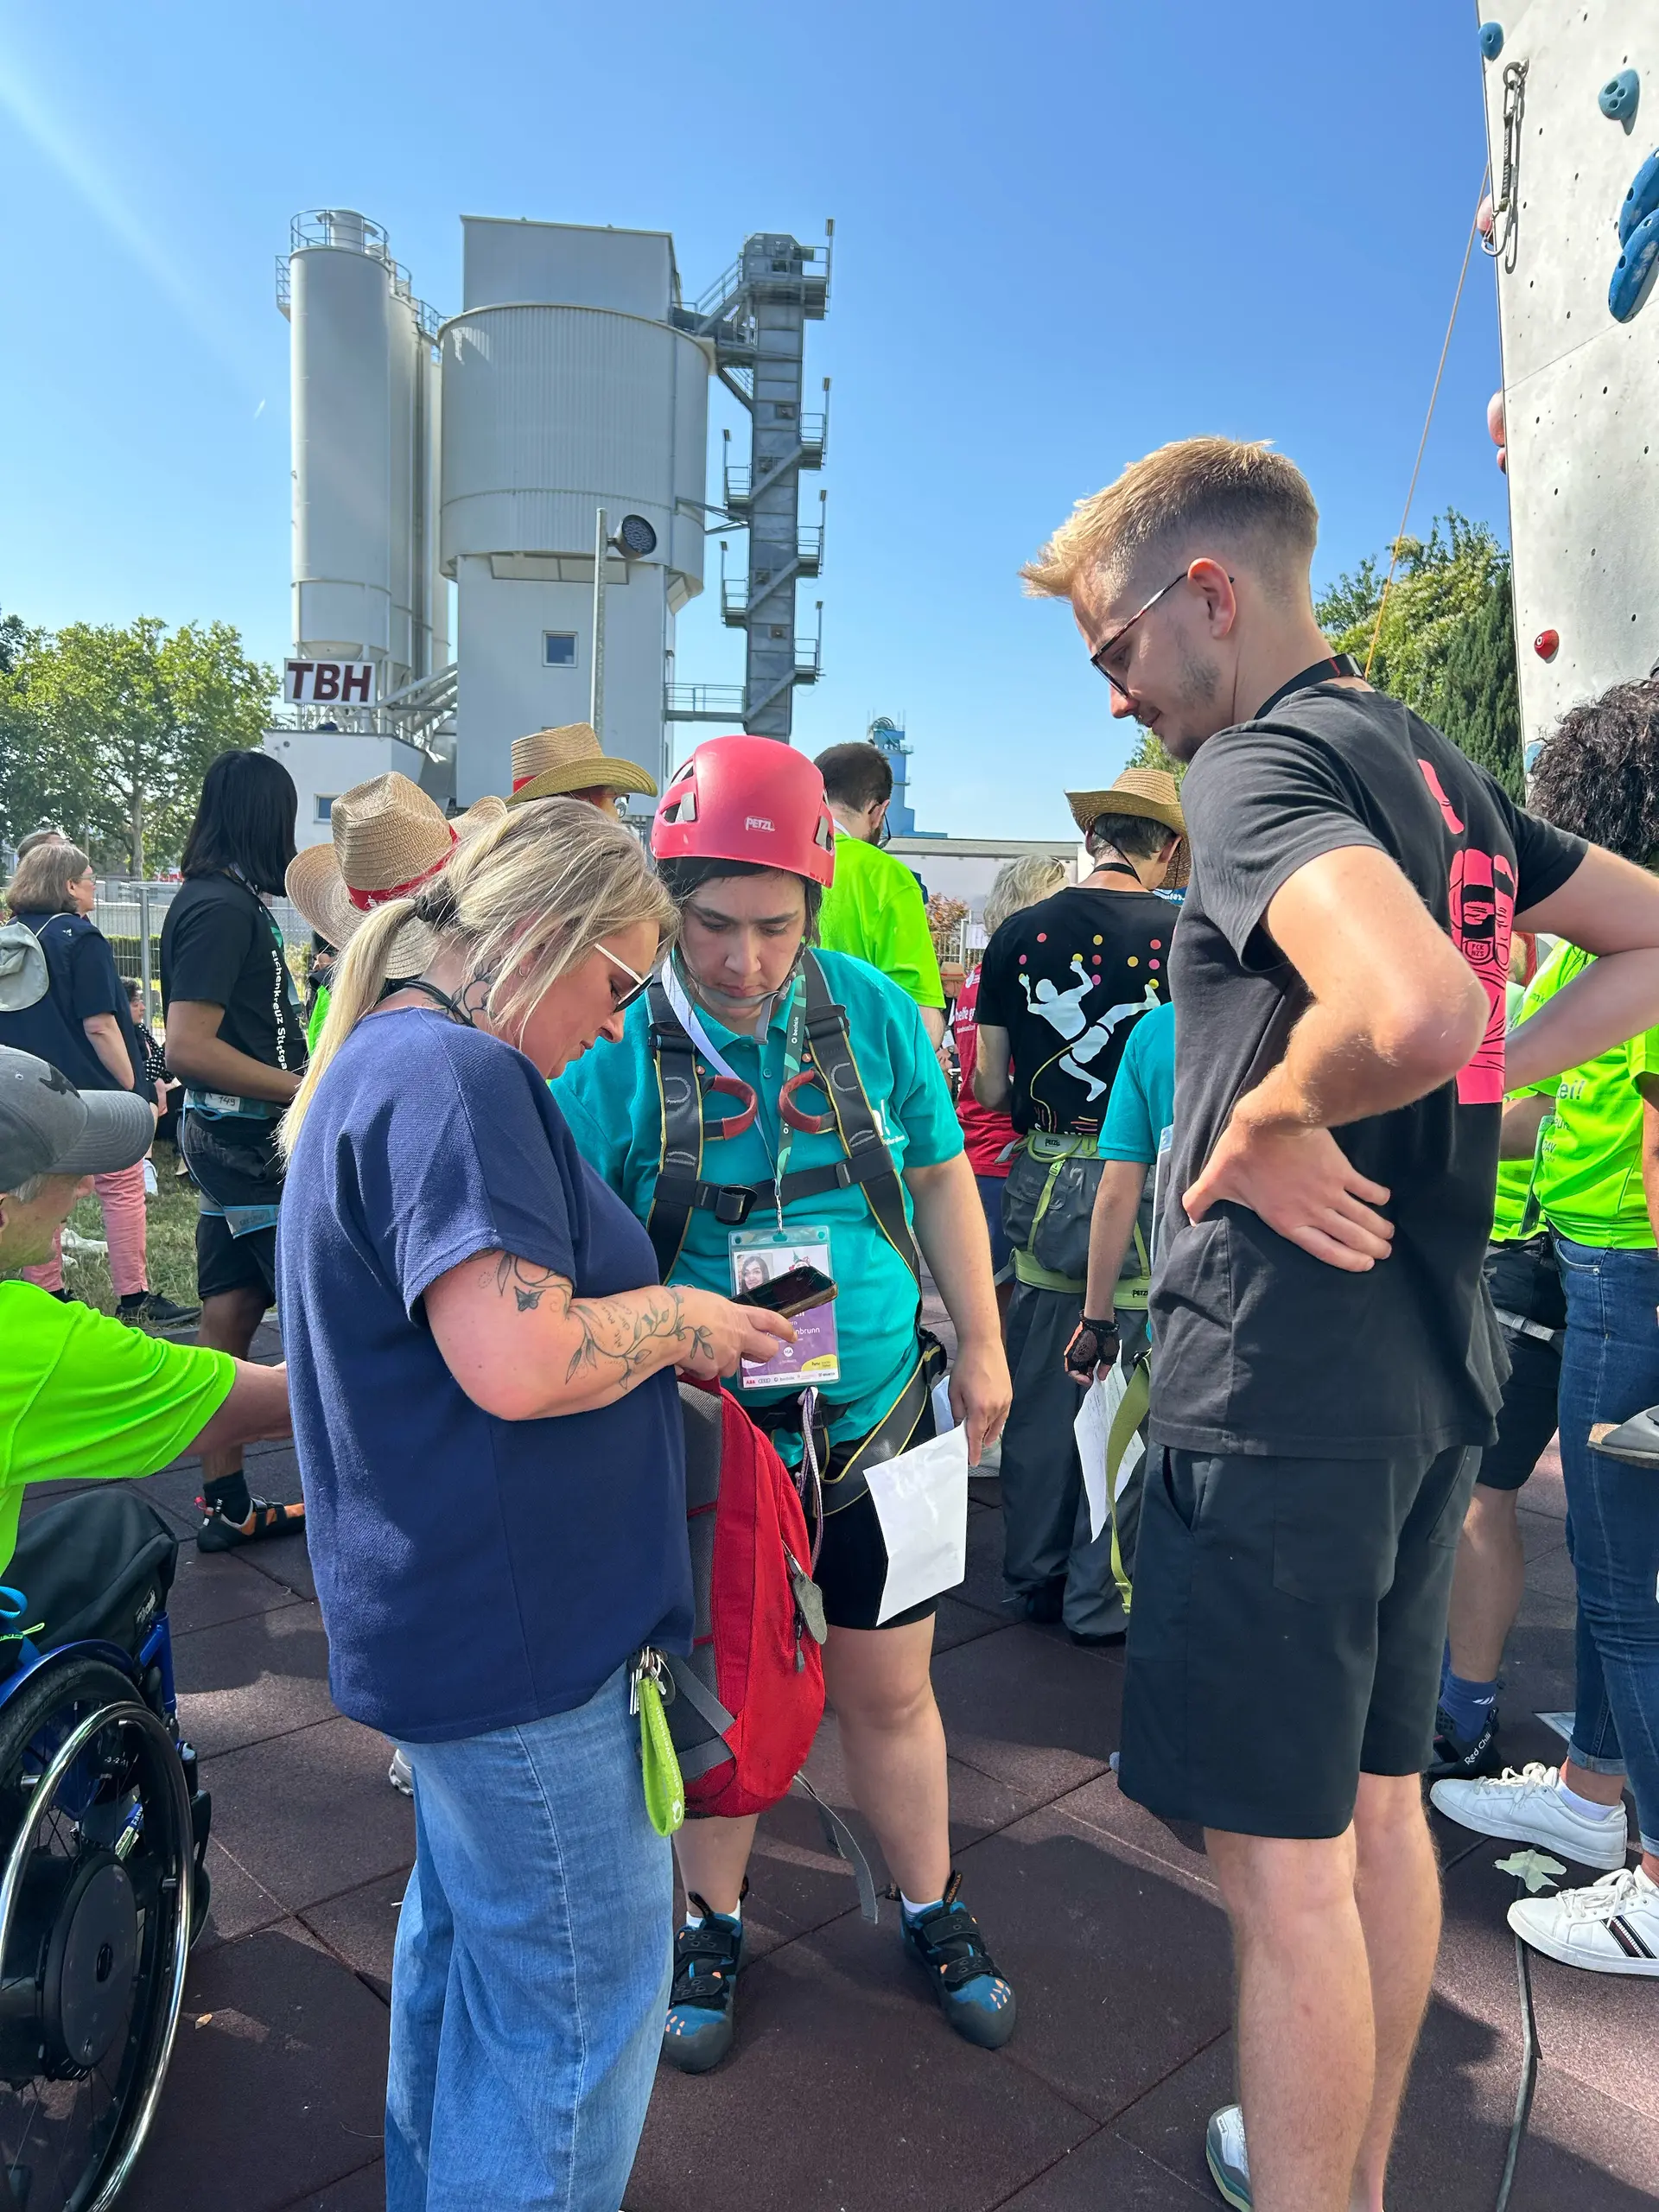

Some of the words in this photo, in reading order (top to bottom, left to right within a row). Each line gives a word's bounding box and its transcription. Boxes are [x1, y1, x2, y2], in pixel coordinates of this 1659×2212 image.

[287, 662, 372, 702] TBH
[746, 817, 775, 831] PETZL
[271, 950, 283, 1024] Eichenkreuz
[276, 1027, 288, 1071] Stuttga
[219, 1096, 236, 1106] 149
[1557, 1079, 1586, 1100] ei!
[1464, 1747, 1479, 1765] Red
[1478, 1731, 1491, 1750] Chili
